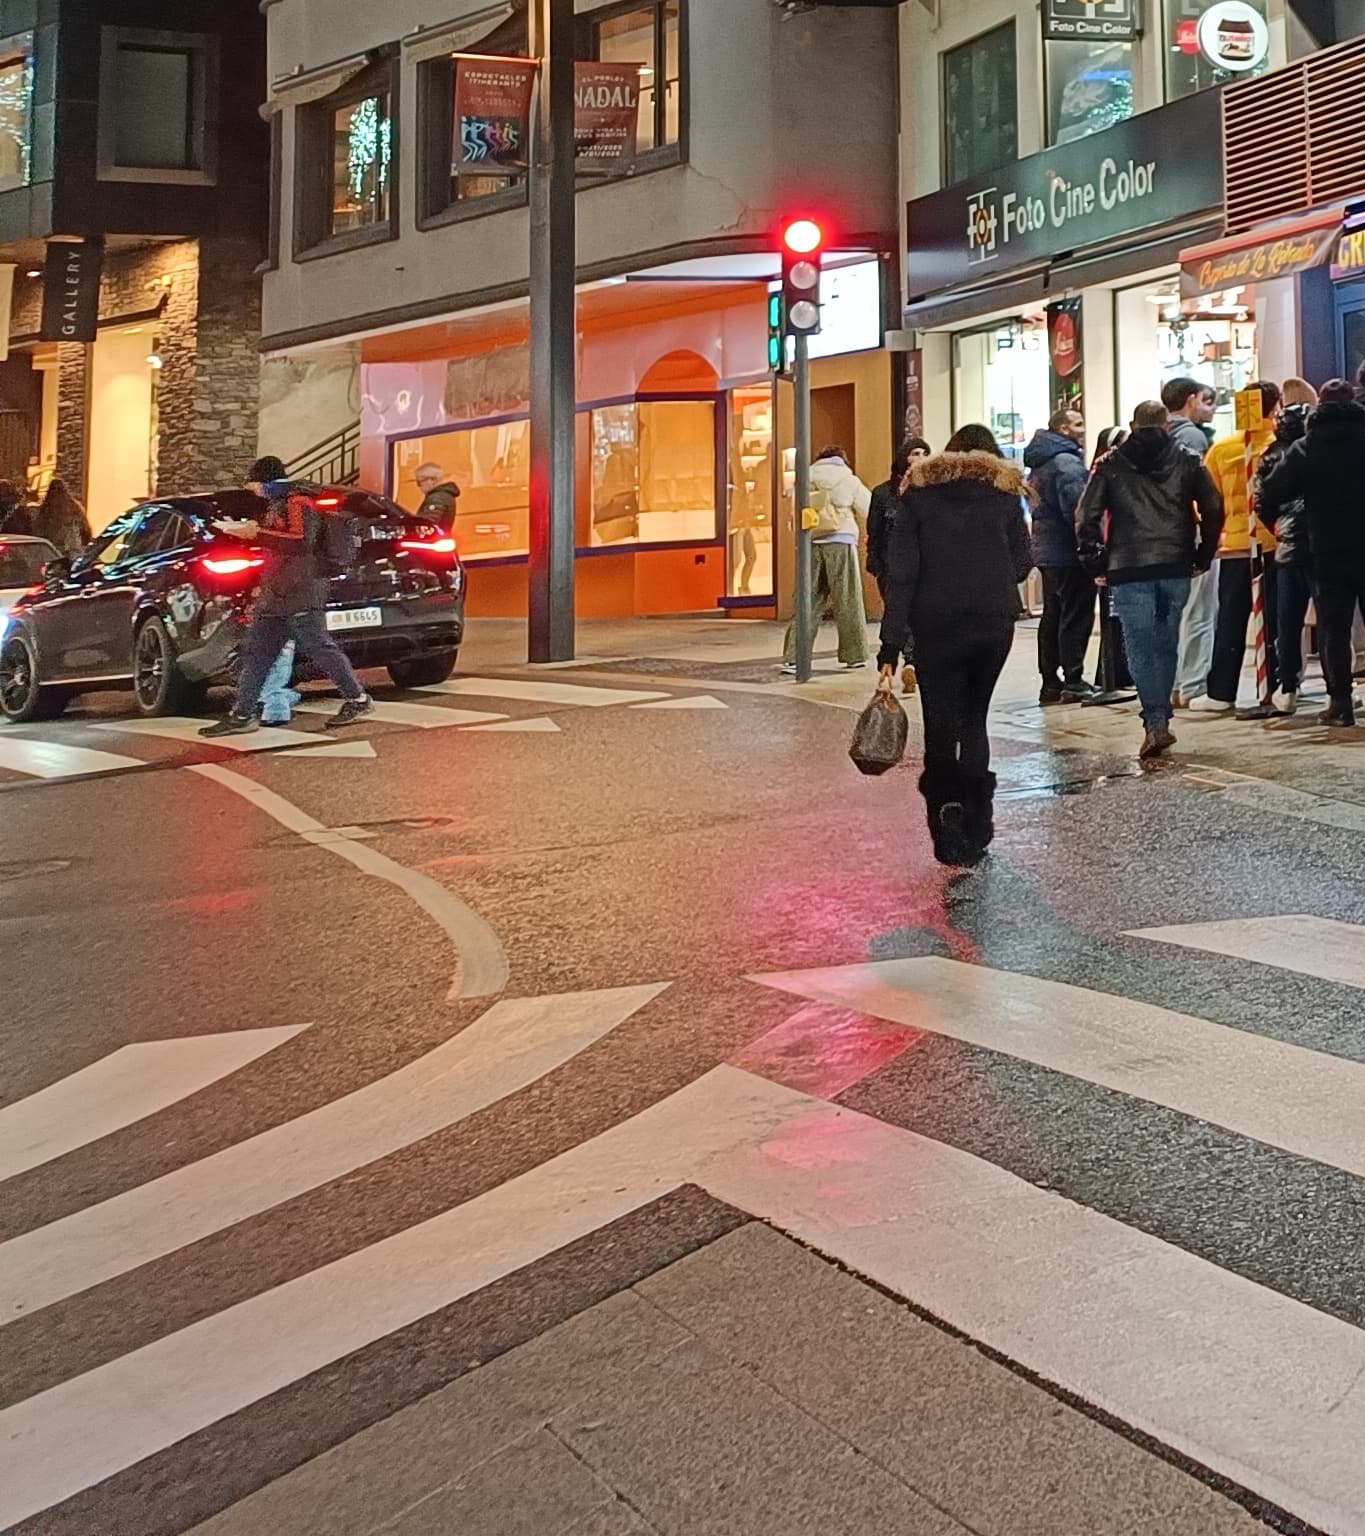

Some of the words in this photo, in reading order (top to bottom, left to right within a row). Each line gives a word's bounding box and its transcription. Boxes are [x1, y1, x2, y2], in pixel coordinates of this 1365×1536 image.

[1050, 20, 1074, 32] Foto
[1077, 22, 1100, 33] Cine
[1103, 23, 1131, 34] Color
[575, 85, 637, 109] NADAL
[1002, 187, 1045, 242] Foto
[1049, 177, 1095, 228] Cine
[1100, 158, 1156, 210] Color
[61, 251, 81, 335] GALLERY
